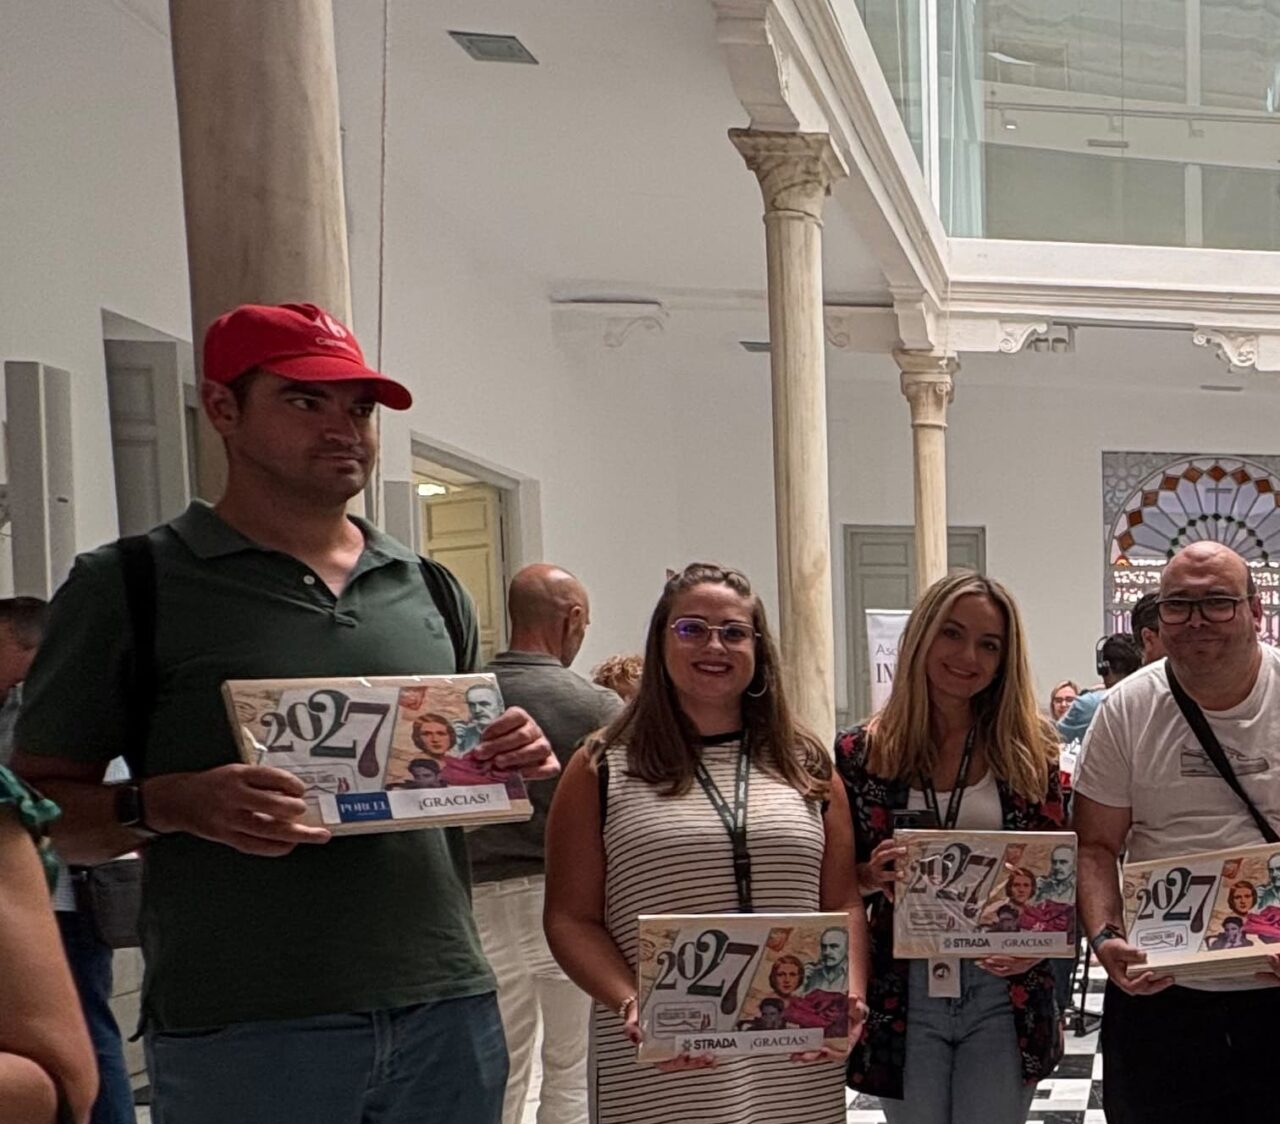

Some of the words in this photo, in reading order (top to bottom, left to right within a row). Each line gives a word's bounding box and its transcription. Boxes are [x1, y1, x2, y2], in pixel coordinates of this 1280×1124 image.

[261, 689, 391, 778] 2027
[418, 793, 490, 811] ¡GRACIAS!
[909, 842, 998, 918] 2027
[1136, 867, 1217, 934] 2027
[655, 929, 760, 1015] 2027
[953, 937, 991, 948] STRADA
[1001, 938, 1054, 949] ¡GRACIAS!
[693, 1037, 737, 1050] STRADA
[750, 1036, 810, 1049] ¡GRACIAS!
